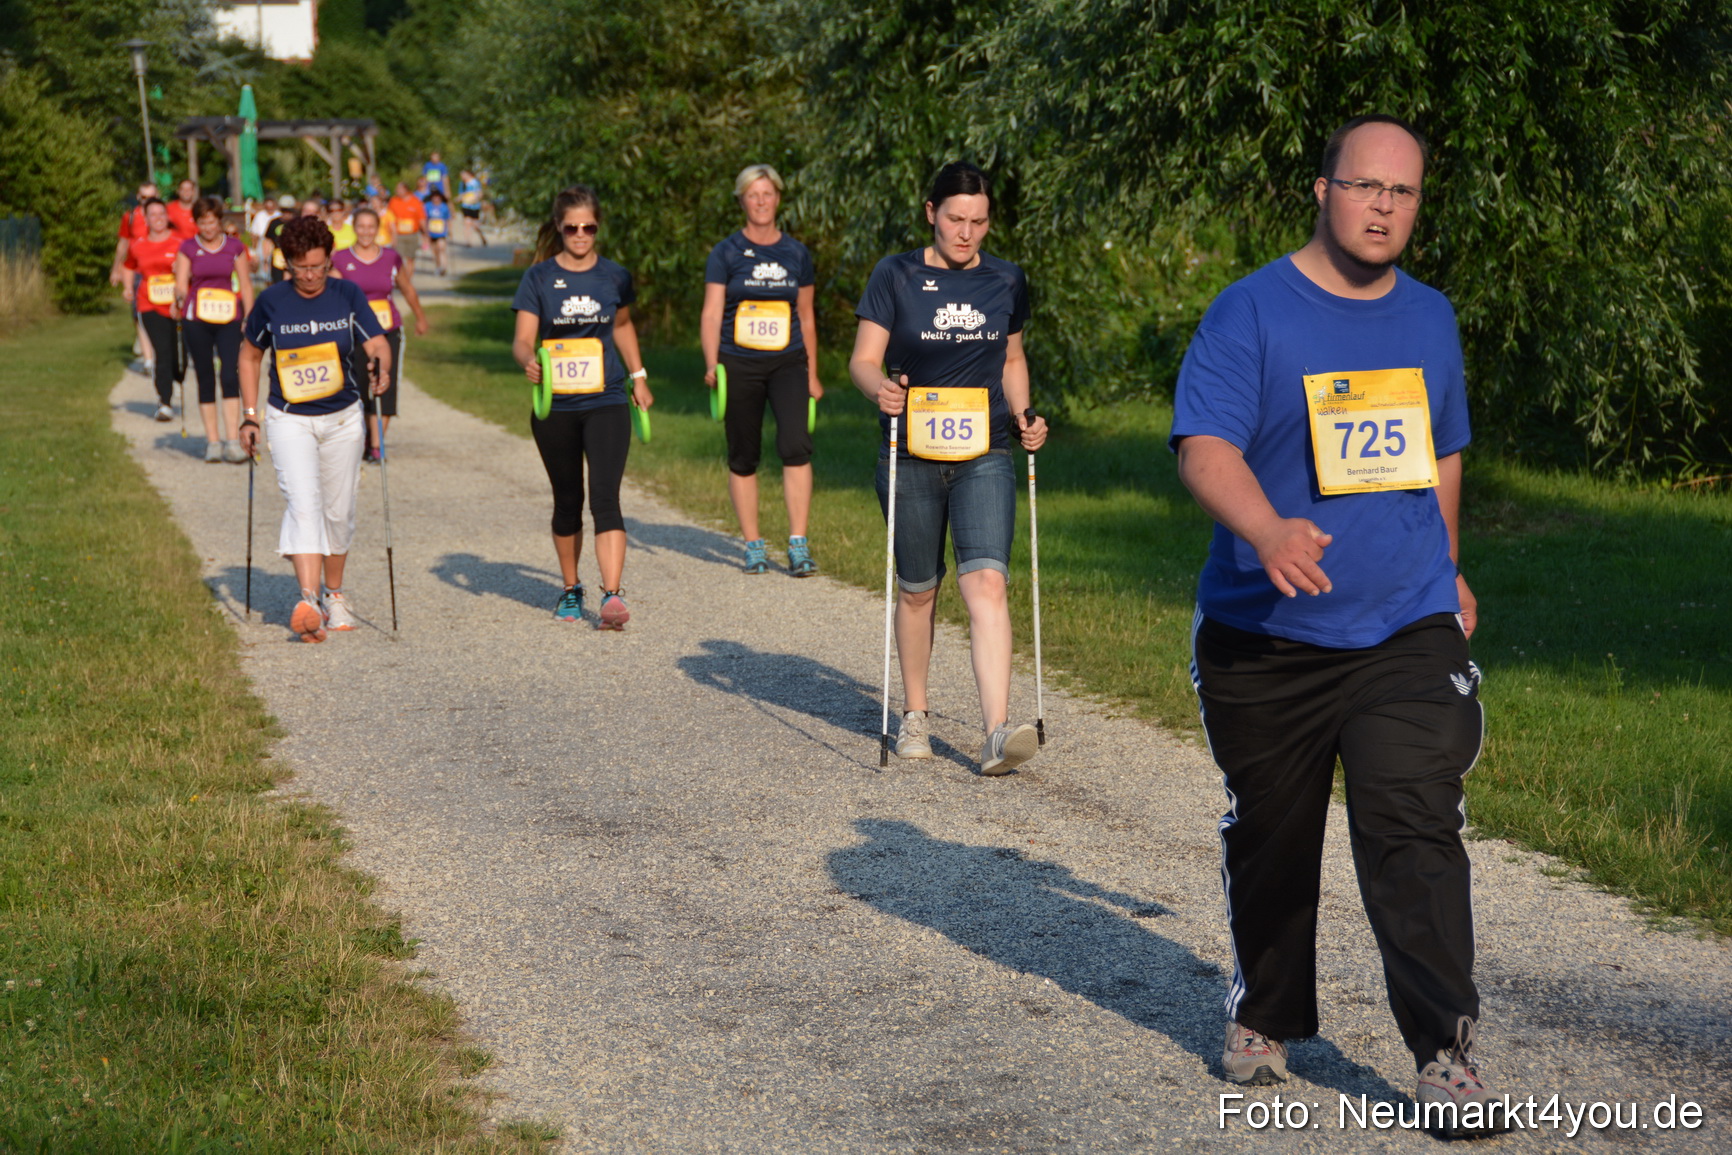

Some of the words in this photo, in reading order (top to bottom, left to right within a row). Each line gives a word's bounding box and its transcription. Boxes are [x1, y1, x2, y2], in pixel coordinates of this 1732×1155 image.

[280, 324, 310, 334] EURO
[318, 318, 348, 329] POLES
[933, 307, 986, 330] Burgis
[748, 321, 779, 336] 186
[921, 331, 951, 340] Weil's
[955, 330, 984, 343] guad
[987, 331, 999, 340] is!
[292, 366, 331, 386] 392
[555, 361, 590, 378] 187
[925, 417, 973, 440] 185
[1334, 419, 1407, 460] 725
[1347, 467, 1379, 475] Bernhard
